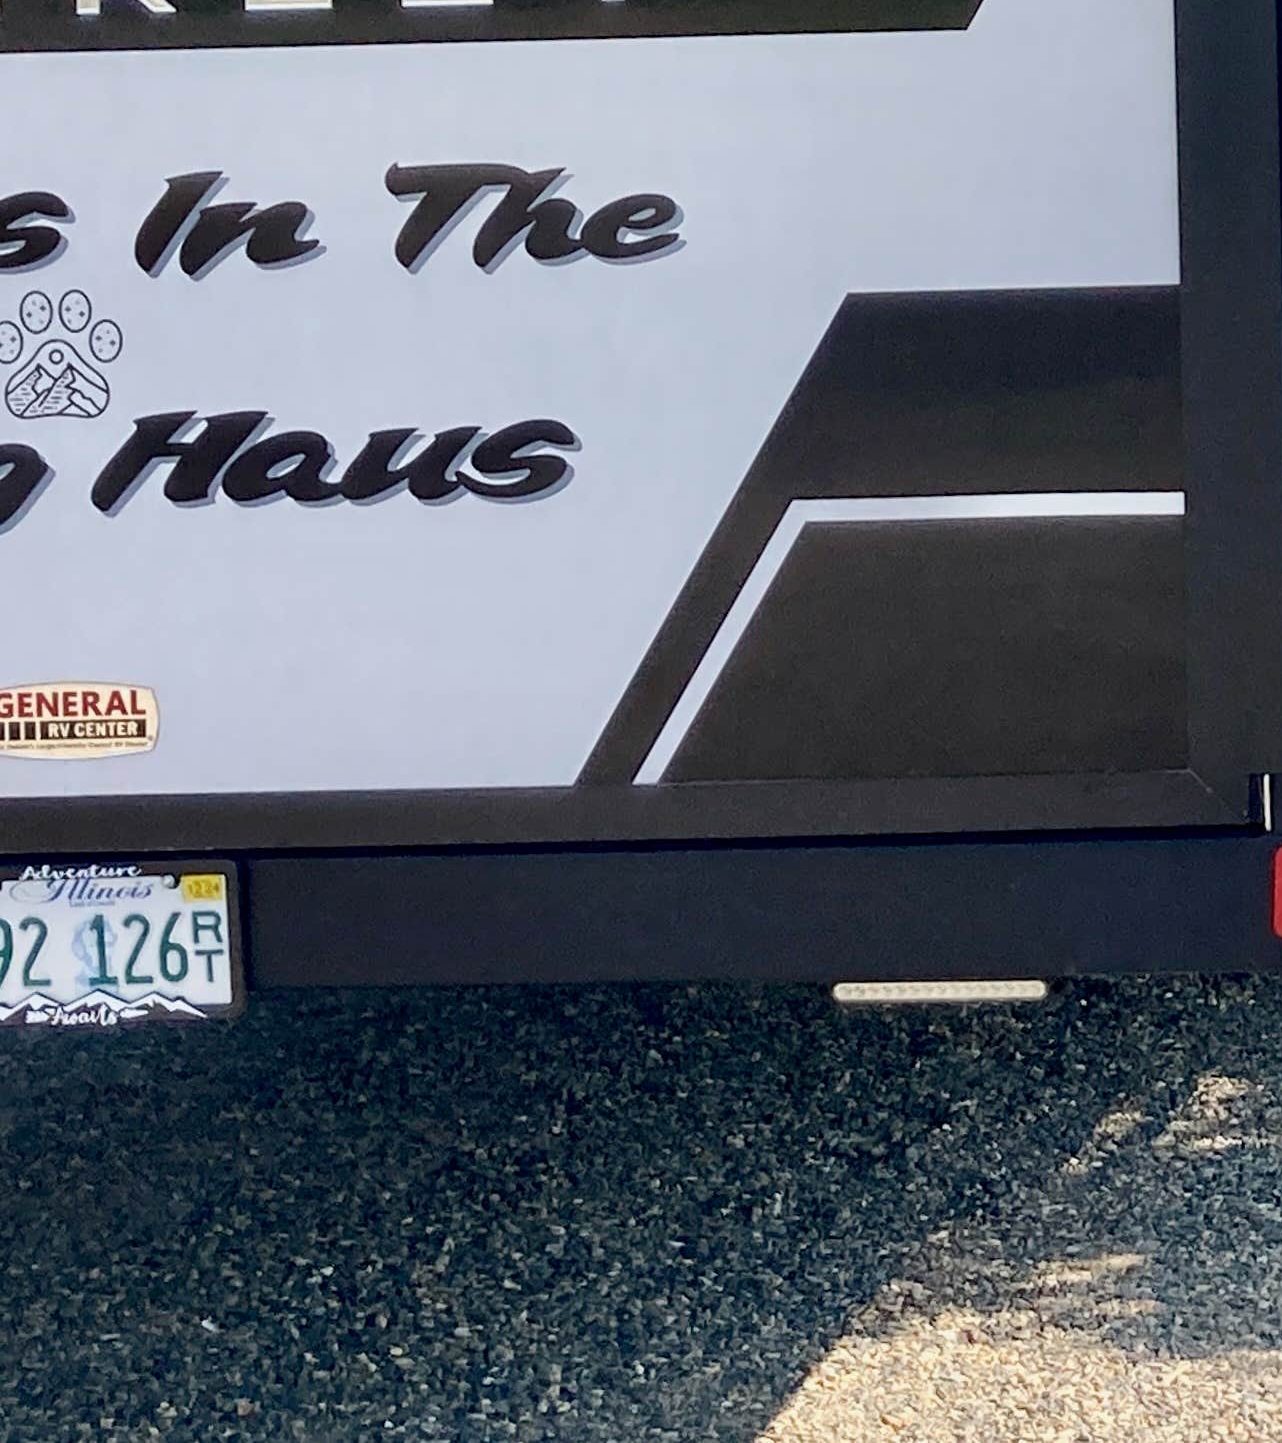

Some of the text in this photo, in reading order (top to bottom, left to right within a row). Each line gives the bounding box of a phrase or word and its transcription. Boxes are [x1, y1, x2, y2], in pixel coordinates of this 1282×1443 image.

[135, 170, 327, 280] In
[384, 161, 688, 274] The
[91, 410, 583, 516] Haus
[0, 689, 147, 718] GENERAL
[47, 721, 138, 738] RV CENTER
[19, 864, 142, 880] Adventure
[28, 877, 152, 902] Illinois
[89, 911, 189, 985] 126
